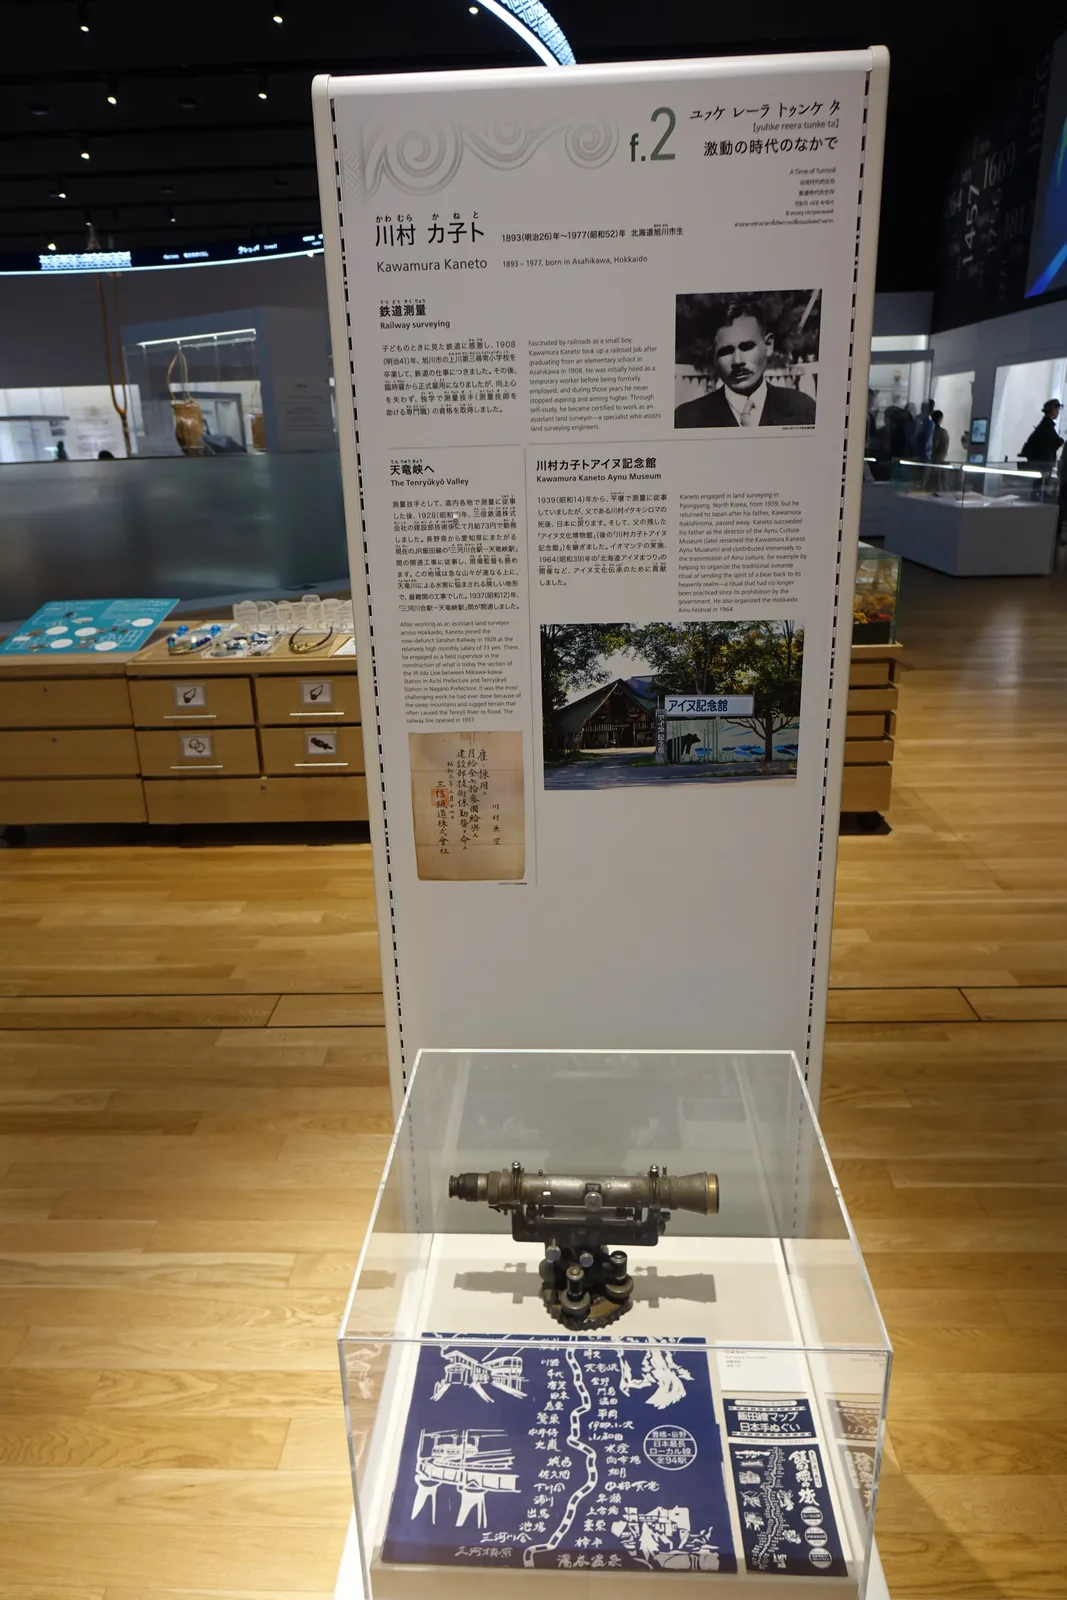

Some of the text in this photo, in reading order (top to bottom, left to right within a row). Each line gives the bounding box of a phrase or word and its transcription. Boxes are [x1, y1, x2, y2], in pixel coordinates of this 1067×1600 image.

[733, 104, 770, 119] レーラ
[782, 122, 801, 130] reera
[804, 120, 825, 129] tunke
[629, 106, 676, 162] f.2
[704, 136, 838, 156] 激動の時代のなかで
[816, 166, 836, 174] Turmoil
[376, 215, 391, 223] かわ
[397, 214, 412, 222] むら
[453, 212, 460, 220] ね
[473, 211, 479, 219] と
[962, 184, 980, 266] 1457
[376, 224, 416, 246] 川村
[631, 227, 684, 237] 北海道旭川市生
[377, 259, 487, 272] Kawamura Kaneto
[526, 259, 543, 267] 1977,
[572, 256, 612, 265] Asahikawa,
[614, 255, 648, 263] Hokkaido
[380, 304, 426, 317] 鉄道測量
[380, 320, 450, 330] Railway surveying
[559, 339, 566, 347] by
[621, 338, 633, 346] boy,
[529, 359, 560, 367] graduating
[584, 357, 616, 365] elementary
[608, 367, 628, 375] initially
[530, 378, 558, 386] temporary
[618, 376, 641, 384] formally
[390, 464, 435, 476] 天竜峡へ
[446, 478, 469, 486] Valley
[607, 474, 627, 482] Aynu
[701, 493, 725, 501] engaged
[746, 492, 773, 500] surveying
[668, 699, 728, 712] アイヌ記念館
[597, 1409, 618, 1420] 平岡
[738, 1411, 798, 1422] 飯田線マップ
[740, 1422, 800, 1432] 日本手ぬぐい
[588, 1432, 624, 1441] 小和田
[538, 1470, 570, 1480] 佐久間
[586, 1506, 619, 1516] 上市場
[480, 1532, 532, 1543] 三河川合
